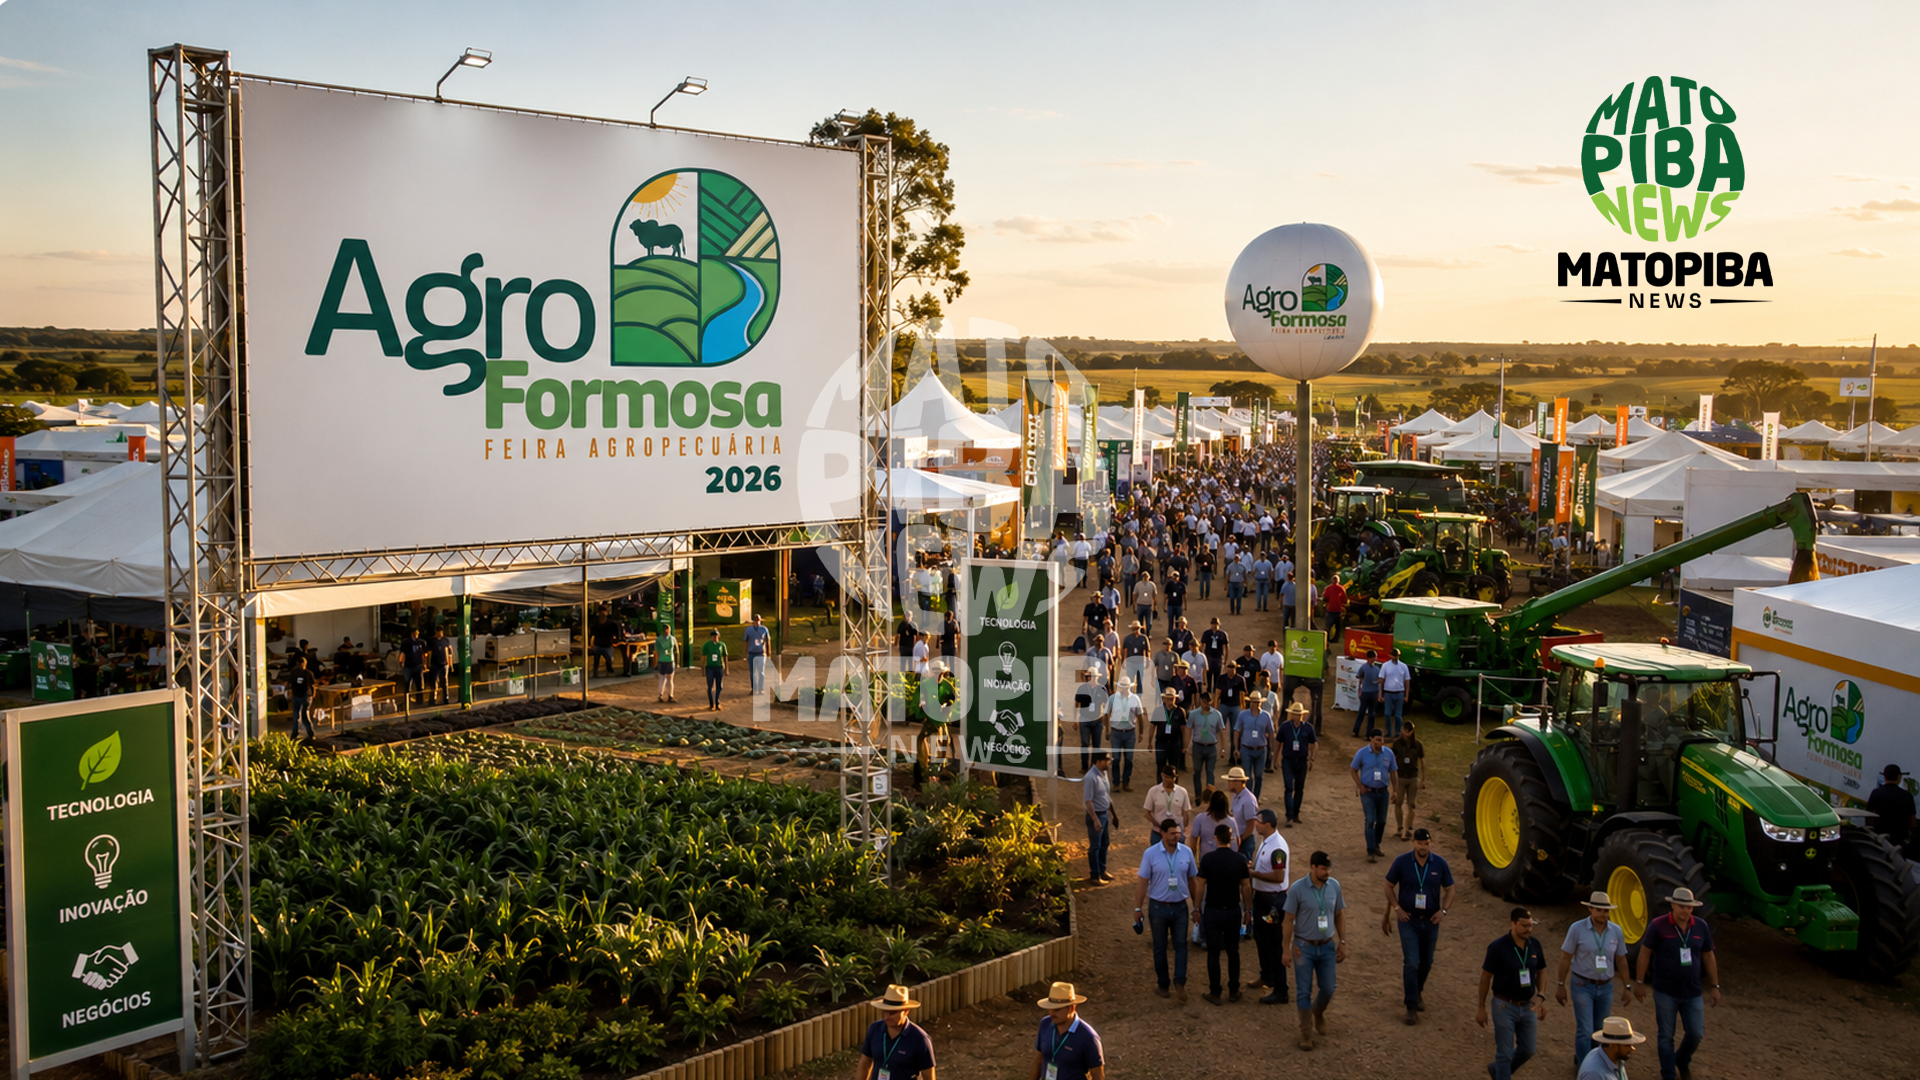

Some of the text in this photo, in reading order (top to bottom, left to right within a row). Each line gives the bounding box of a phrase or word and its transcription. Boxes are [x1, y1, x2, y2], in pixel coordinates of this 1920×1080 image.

[304, 238, 597, 397] Agro
[1242, 283, 1298, 318] Agro
[1271, 310, 1347, 327] Formosa
[485, 360, 782, 430] Formosa
[485, 433, 782, 460] FEIRA AGROPECUÁRIA
[705, 465, 782, 494] 2026
[979, 616, 1037, 631] TECNOLOGIA
[983, 678, 1031, 693] INOVAÇÃO
[1783, 686, 1828, 737] Agro
[983, 741, 1031, 756] NEGÓCIOS
[1807, 727, 1863, 770] Formosa
[47, 787, 155, 821] TECNOLOGIA
[59, 888, 148, 923] INOVAÇÃO
[62, 990, 151, 1029] NEGÓCIOS
